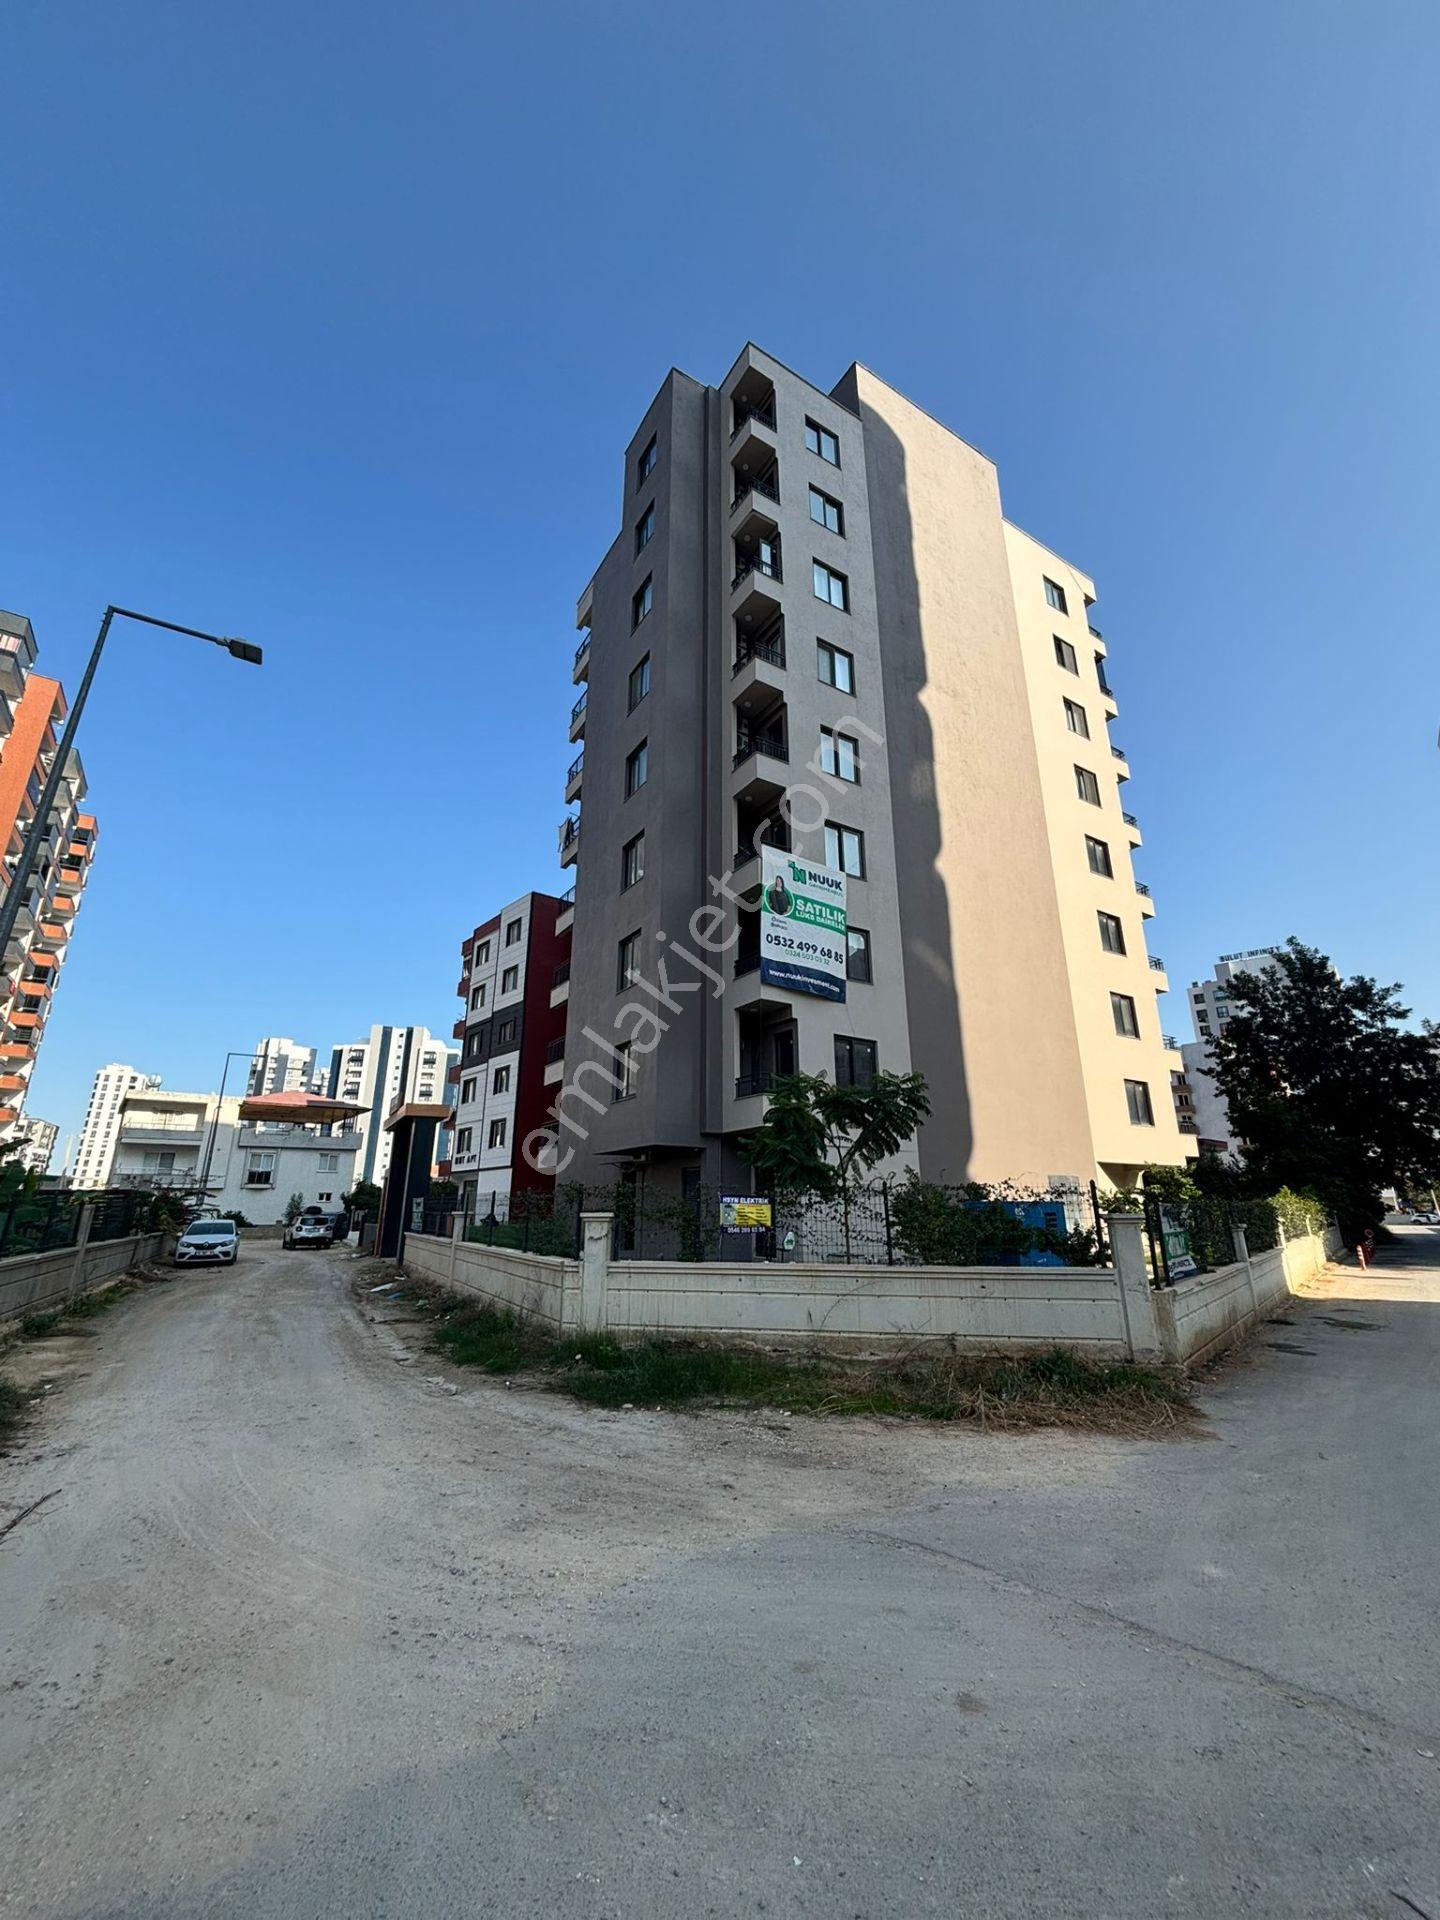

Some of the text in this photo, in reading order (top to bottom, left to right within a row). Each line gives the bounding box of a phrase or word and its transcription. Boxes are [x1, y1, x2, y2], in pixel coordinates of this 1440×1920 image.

[808, 870, 843, 892] NUUK
[796, 899, 845, 925] SATILIK
[766, 933, 844, 965] 0532 499 68 85
